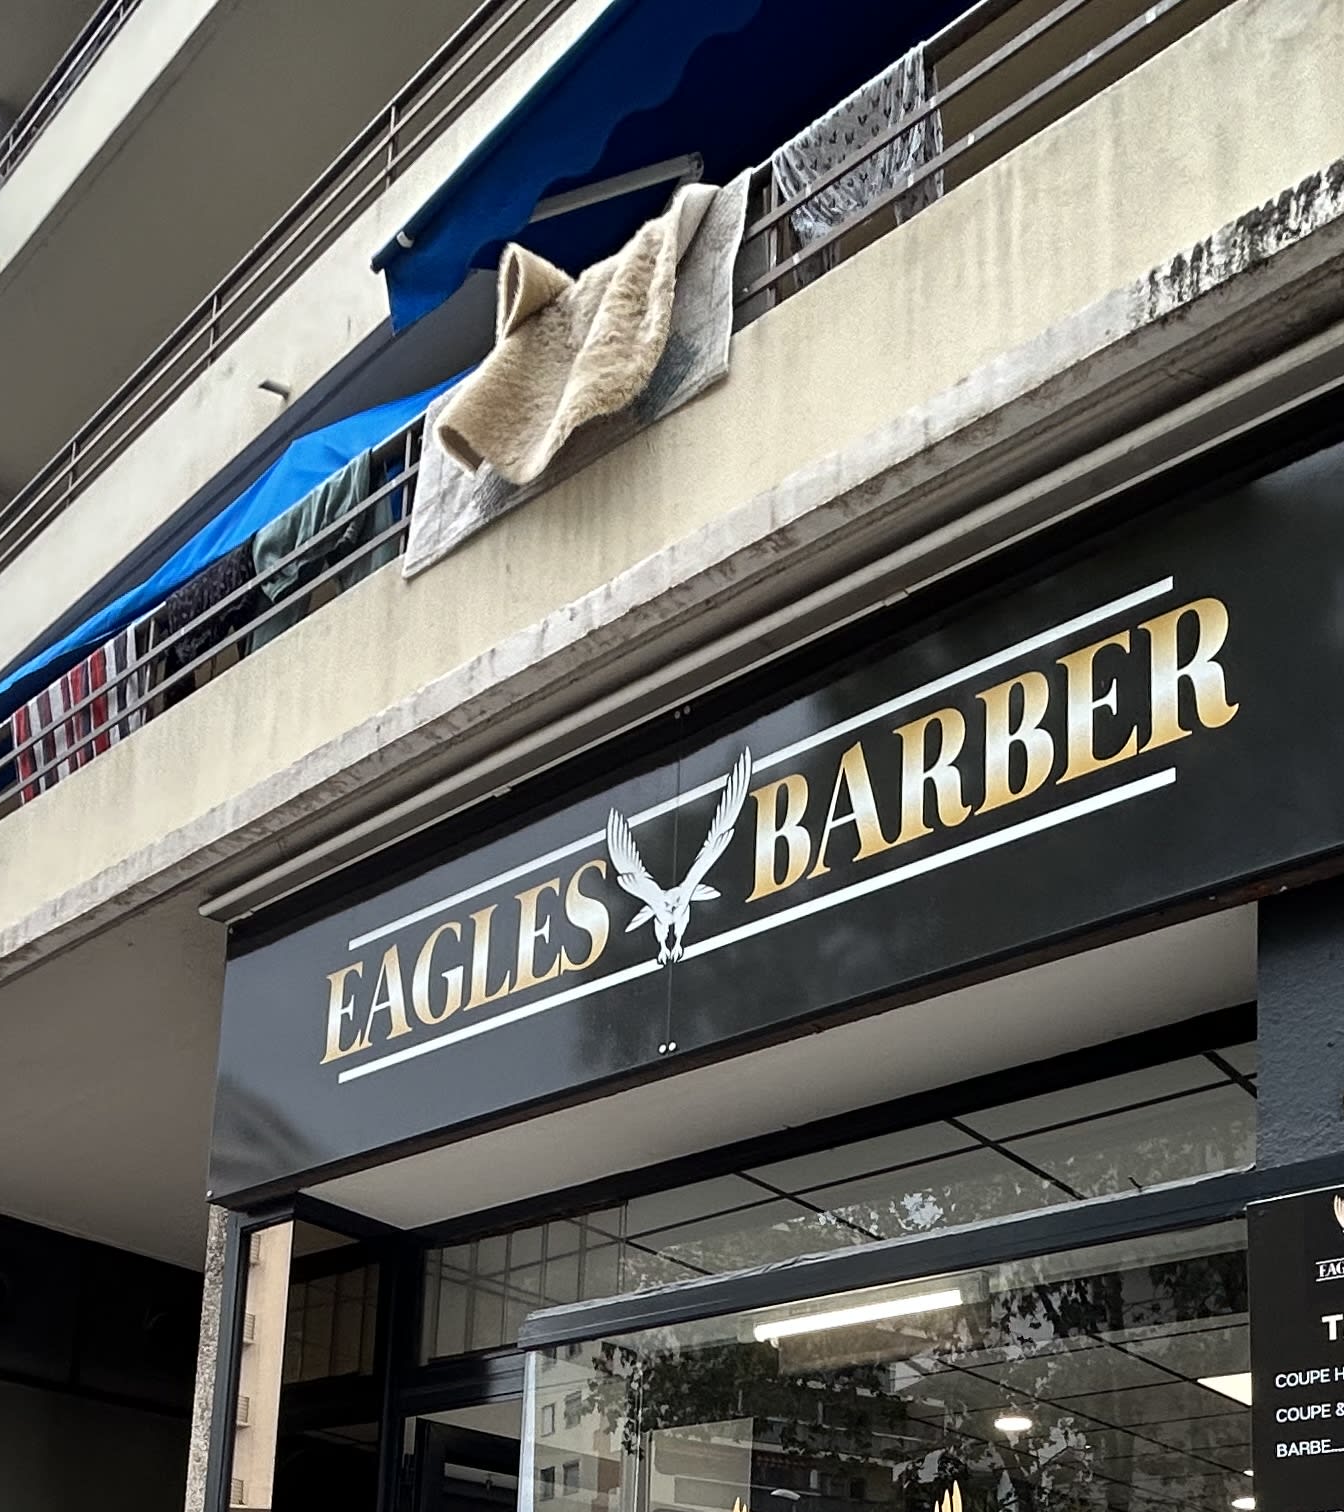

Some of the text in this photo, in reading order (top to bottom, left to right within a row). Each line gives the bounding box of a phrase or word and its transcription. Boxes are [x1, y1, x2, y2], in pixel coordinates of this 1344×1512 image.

[321, 597, 1239, 1065] EAGLES BARBER
[1275, 1368, 1331, 1388] COUPE
[1275, 1402, 1332, 1423] COUPE
[1276, 1438, 1332, 1458] BARBE
